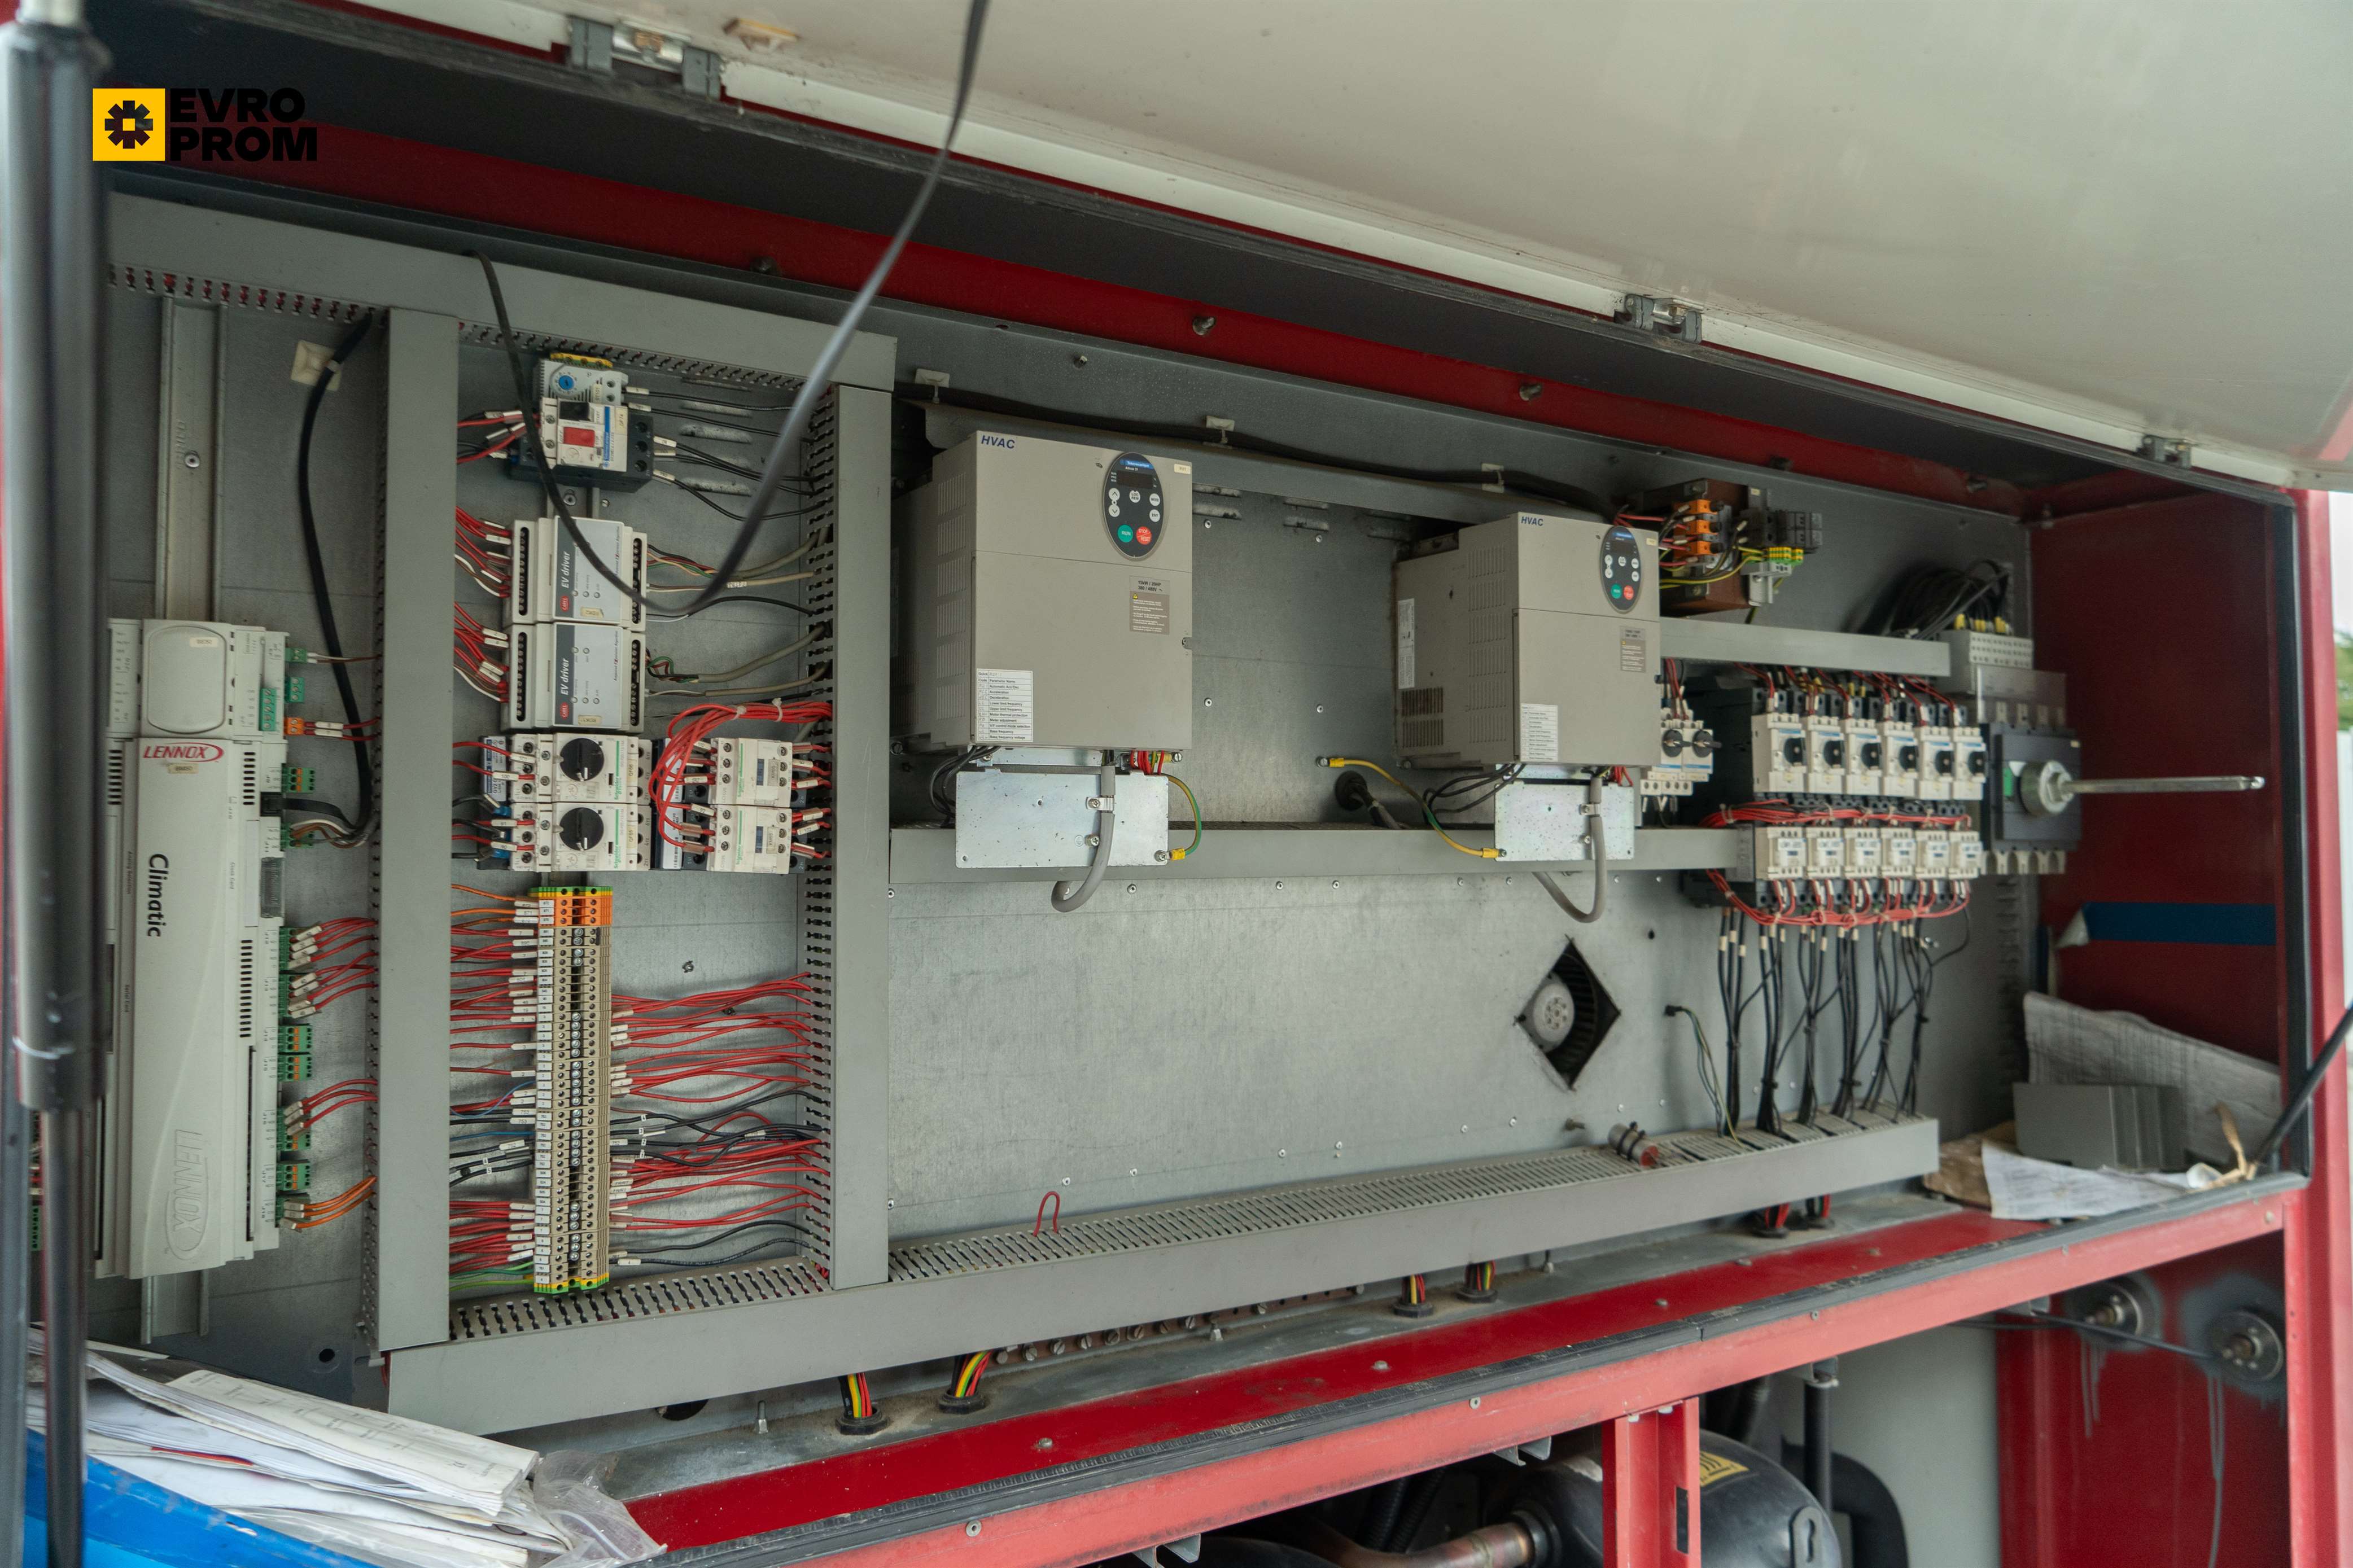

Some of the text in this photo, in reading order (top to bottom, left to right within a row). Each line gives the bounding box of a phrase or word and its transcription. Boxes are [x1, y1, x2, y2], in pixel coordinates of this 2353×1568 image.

[981, 435, 1015, 449] HVAC
[1521, 516, 1543, 526] HVAC
[560, 550, 570, 589] EV driver
[559, 658, 569, 695] EV driver
[143, 745, 209, 759] LENNOX
[147, 853, 169, 937] Climatic
[173, 1129, 203, 1234] LENNOX
